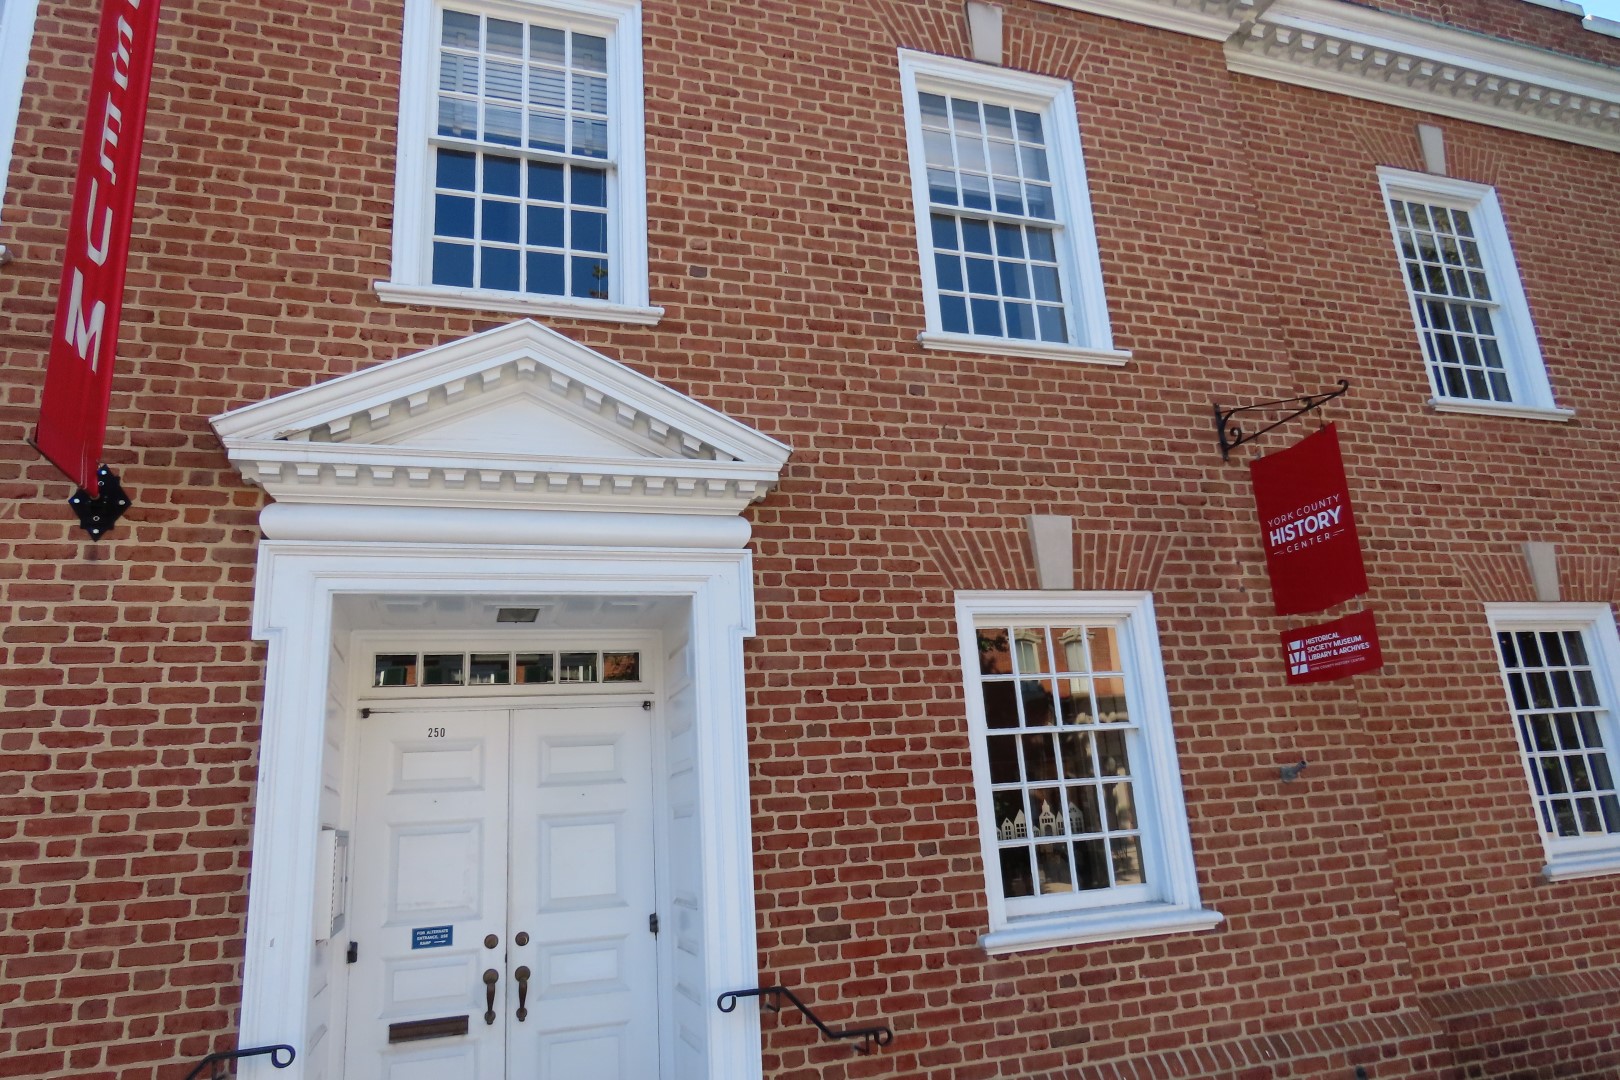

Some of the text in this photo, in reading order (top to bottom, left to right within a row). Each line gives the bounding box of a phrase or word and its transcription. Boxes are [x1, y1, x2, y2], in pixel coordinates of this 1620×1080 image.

[65, 0, 140, 374] SEUM
[1267, 493, 1340, 527] YORK COUNTY
[1269, 505, 1342, 547] HISTORY
[1286, 532, 1331, 553] CENTER
[1305, 632, 1340, 645] HISTORICAL
[1307, 635, 1362, 653] SOCIETY MUSEUM
[1308, 649, 1332, 661] LIBRARY
[1338, 642, 1370, 654] ARCHIVES
[428, 727, 446, 738] 250
